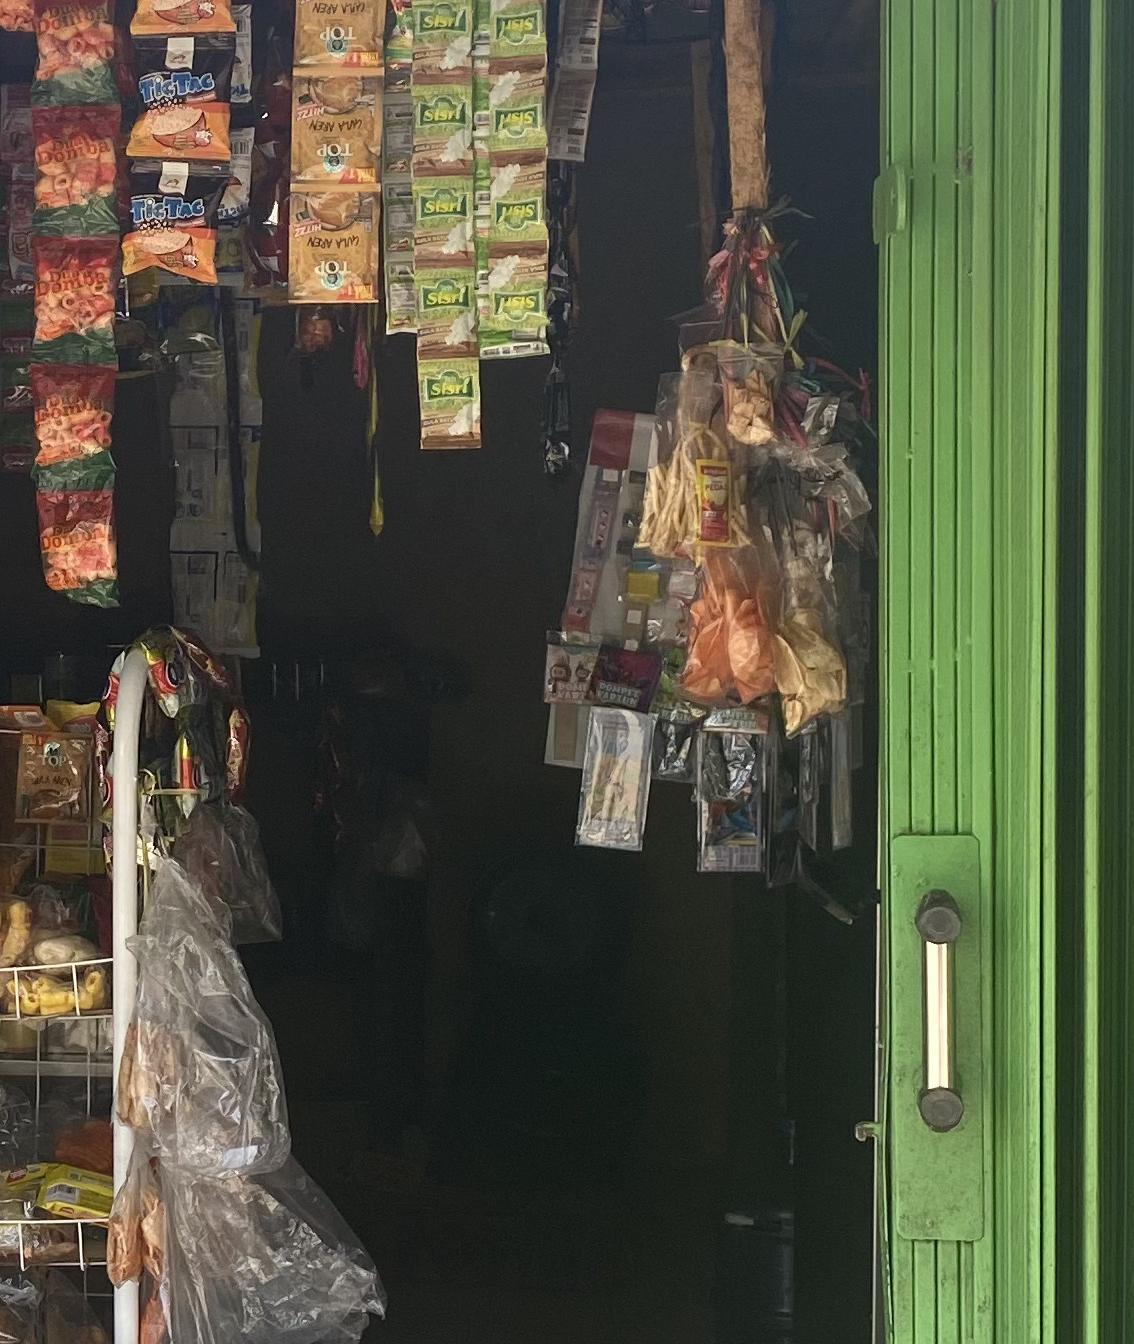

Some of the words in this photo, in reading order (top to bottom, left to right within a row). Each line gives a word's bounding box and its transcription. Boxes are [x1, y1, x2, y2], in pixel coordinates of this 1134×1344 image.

[319, 26, 357, 41] TOP
[139, 72, 215, 103] TicTac
[308, 119, 335, 132] AREN
[317, 143, 354, 156] TOP
[131, 196, 205, 223] TicTac
[306, 236, 333, 249] AREN
[314, 260, 352, 275] TOP
